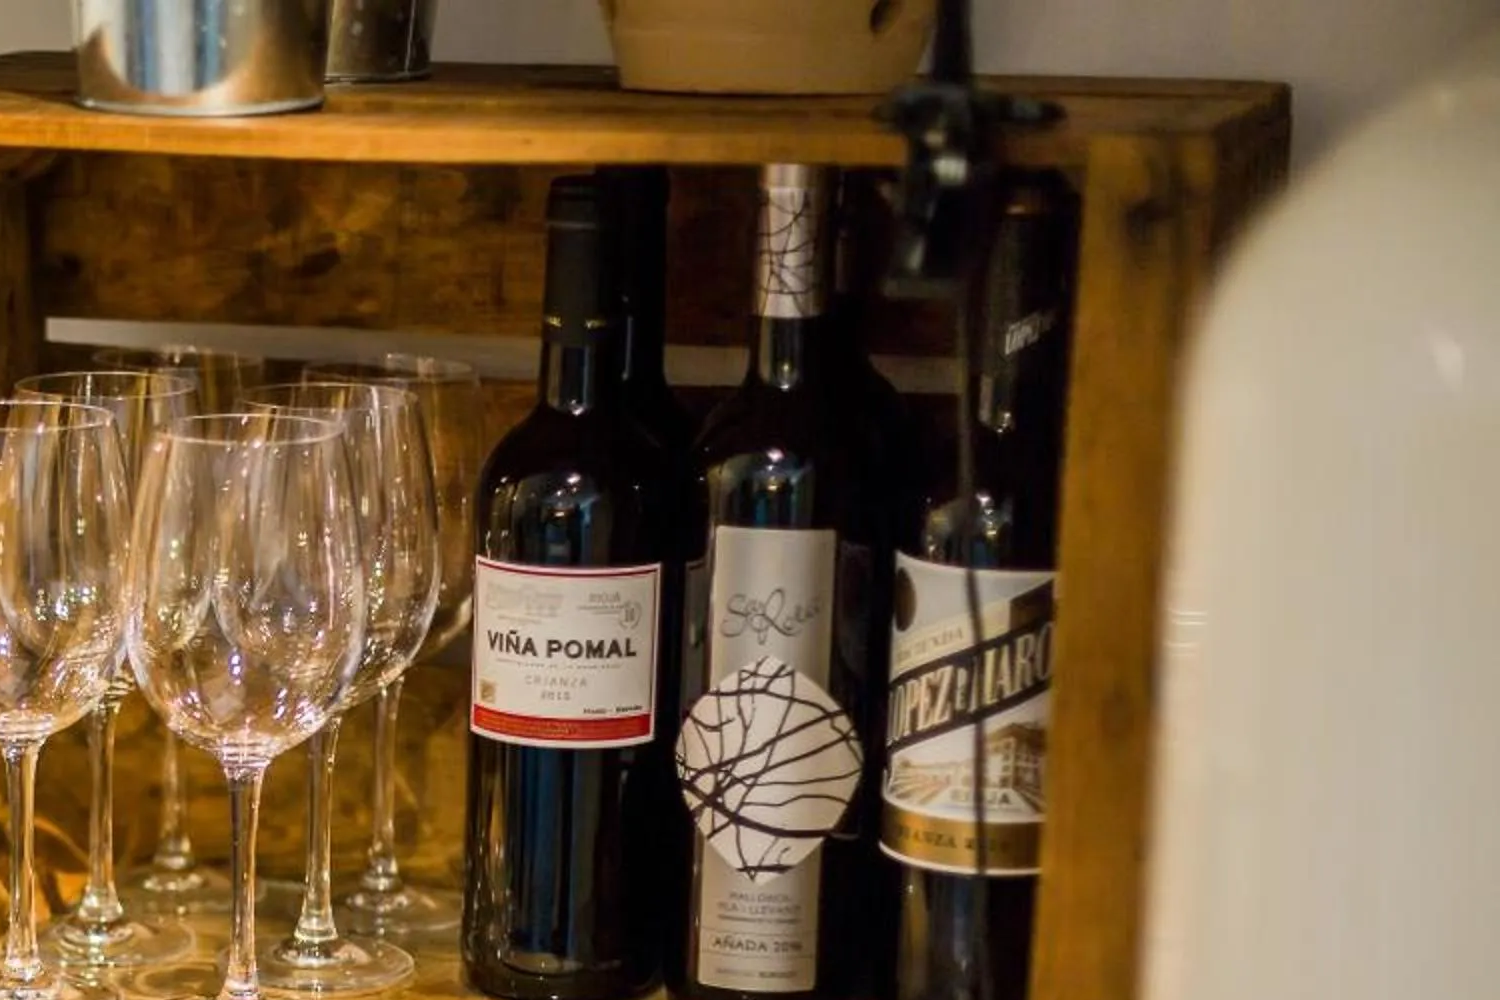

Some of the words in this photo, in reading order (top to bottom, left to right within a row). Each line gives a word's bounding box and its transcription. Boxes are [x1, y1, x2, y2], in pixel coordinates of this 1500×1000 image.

[487, 629, 538, 657] VIÑA
[546, 638, 637, 659] POMAL
[525, 674, 588, 687] CRIANZA
[712, 935, 768, 953] AÑADA
